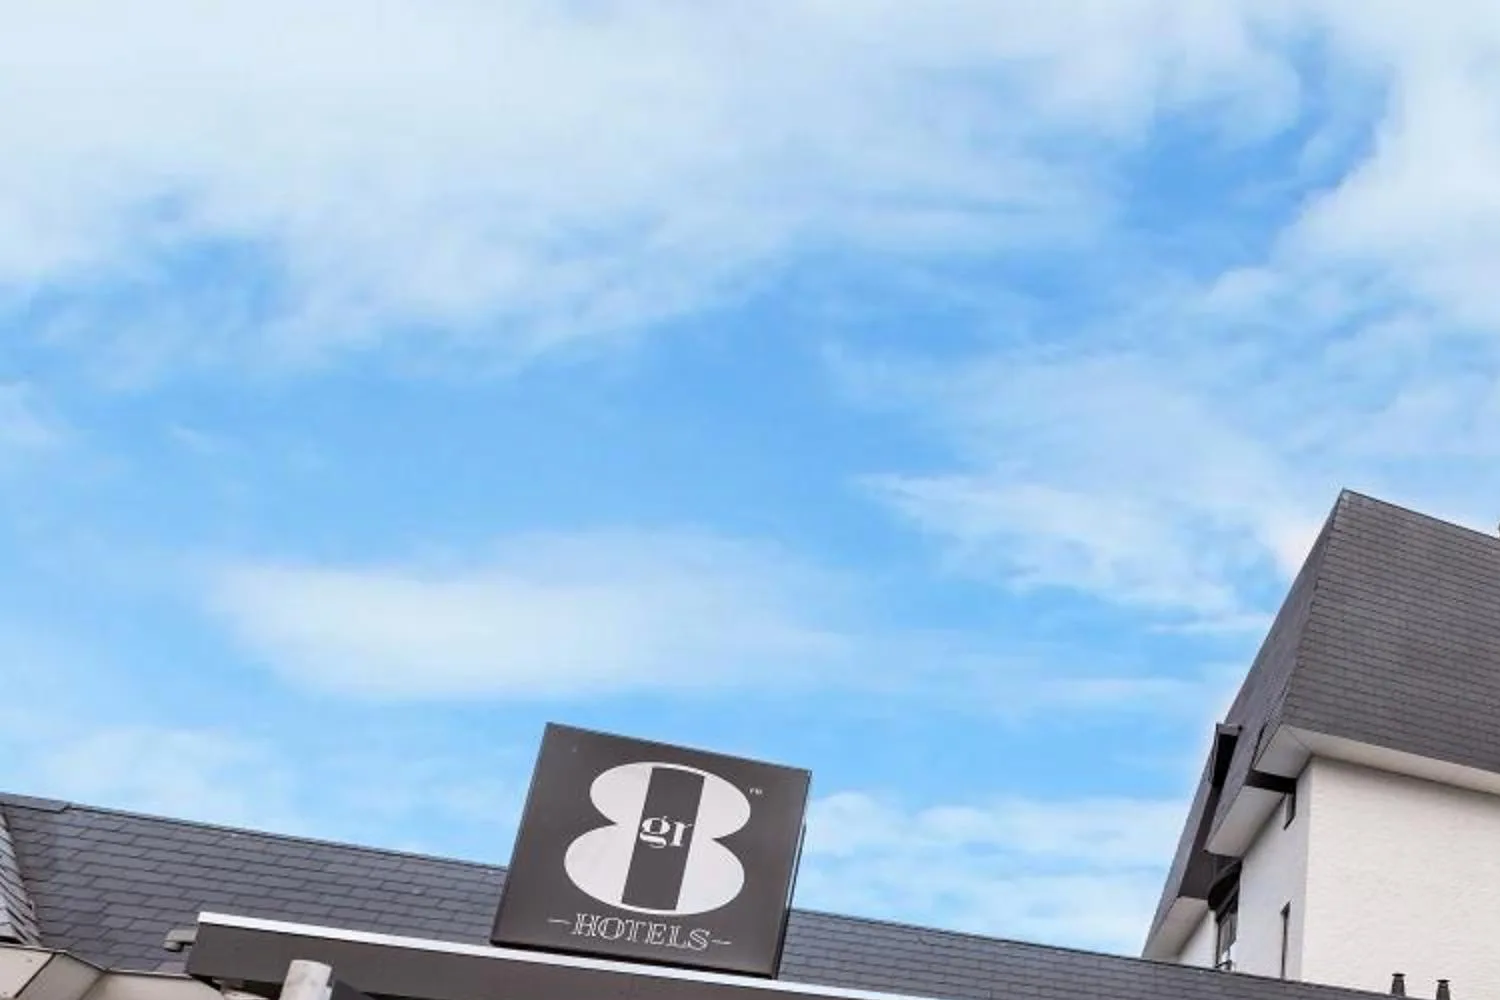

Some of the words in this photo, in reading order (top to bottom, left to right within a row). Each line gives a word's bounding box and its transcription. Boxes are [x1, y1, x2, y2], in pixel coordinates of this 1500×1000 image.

[564, 761, 751, 916] 8
[639, 815, 694, 849] gr
[571, 912, 712, 951] HOTELS
